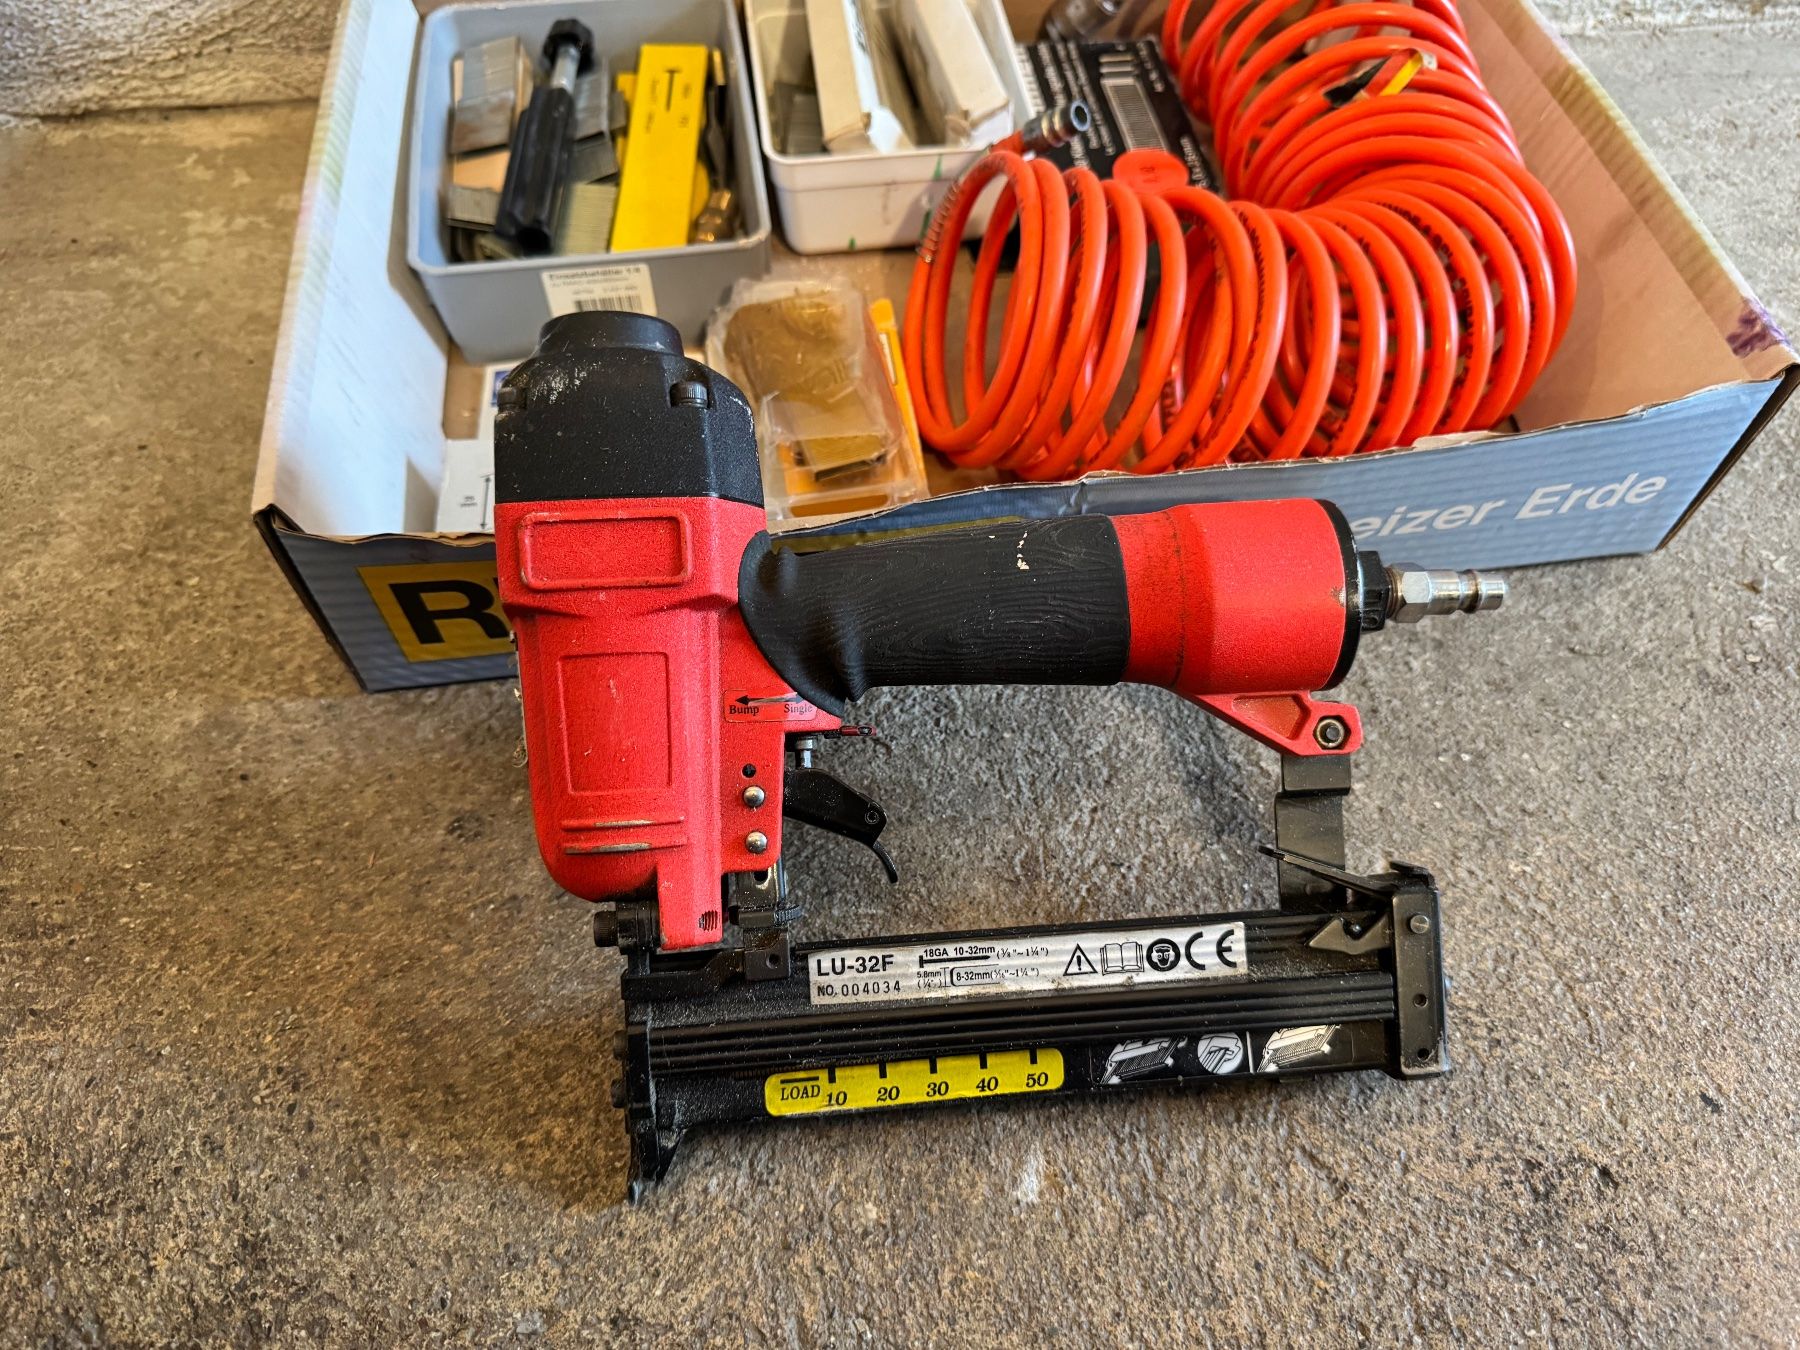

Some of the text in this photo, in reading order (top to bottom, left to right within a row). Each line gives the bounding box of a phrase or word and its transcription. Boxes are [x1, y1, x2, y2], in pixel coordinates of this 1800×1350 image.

[1351, 472, 1667, 540] eizer Erde
[389, 577, 511, 645] R
[729, 703, 813, 716] Bump Single
[923, 949, 949, 958] 18GA
[953, 945, 996, 956] 10-32mm
[1185, 929, 1237, 970] CE
[817, 954, 894, 977] LU-32F
[916, 970, 942, 979] 5.8mm
[841, 980, 901, 997] 004034
[780, 1071, 1049, 1107] LOAD 10 20 30 40 50
